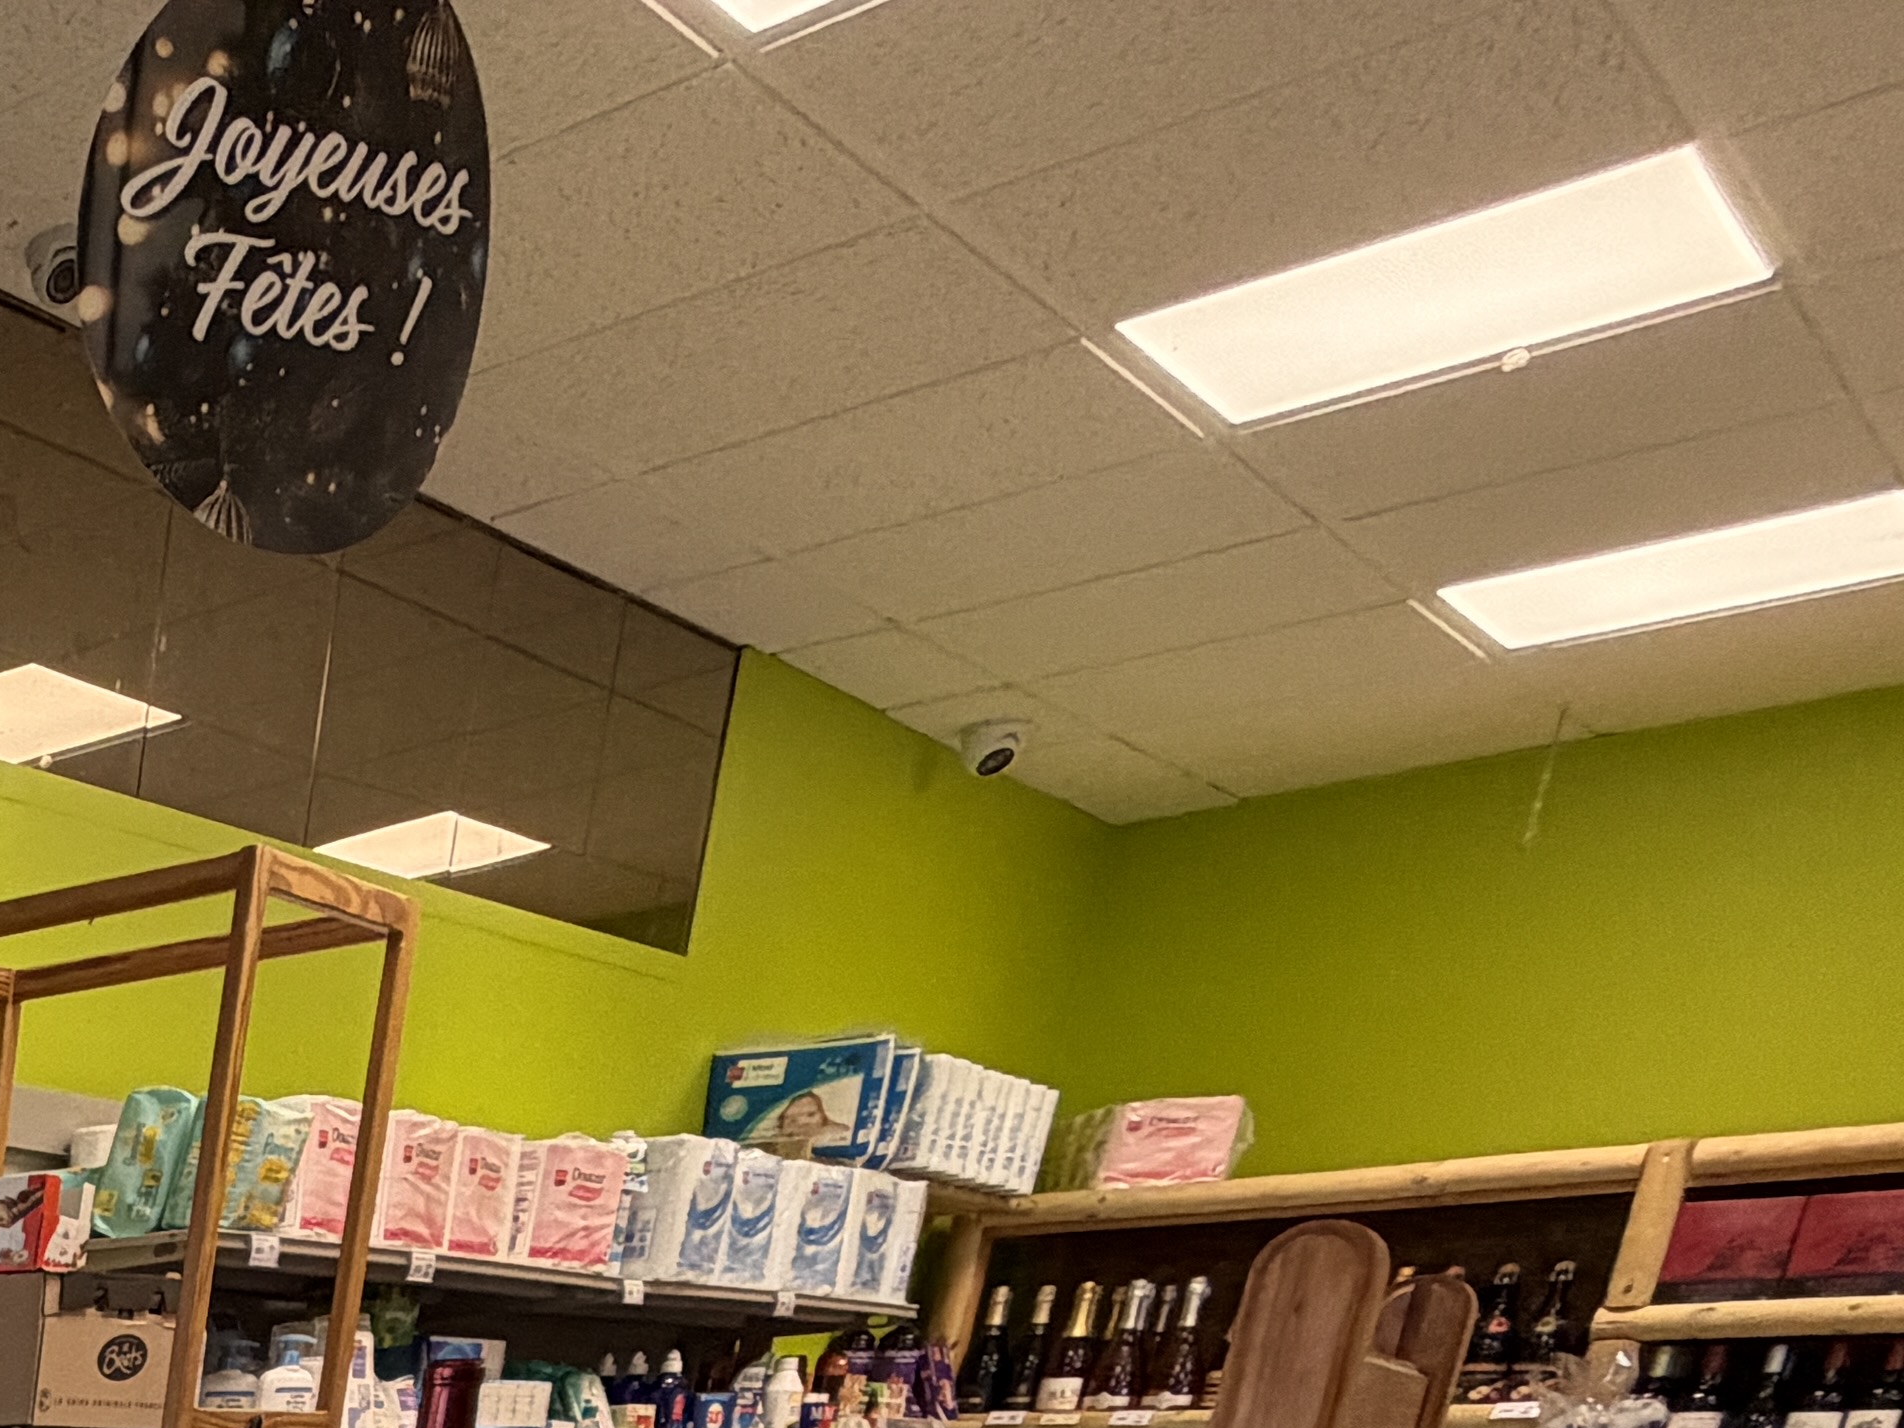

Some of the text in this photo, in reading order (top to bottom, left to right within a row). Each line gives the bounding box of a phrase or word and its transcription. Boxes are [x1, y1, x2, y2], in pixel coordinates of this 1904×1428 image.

[118, 76, 476, 238] Joyeuses
[183, 229, 432, 367] Fêtes !
